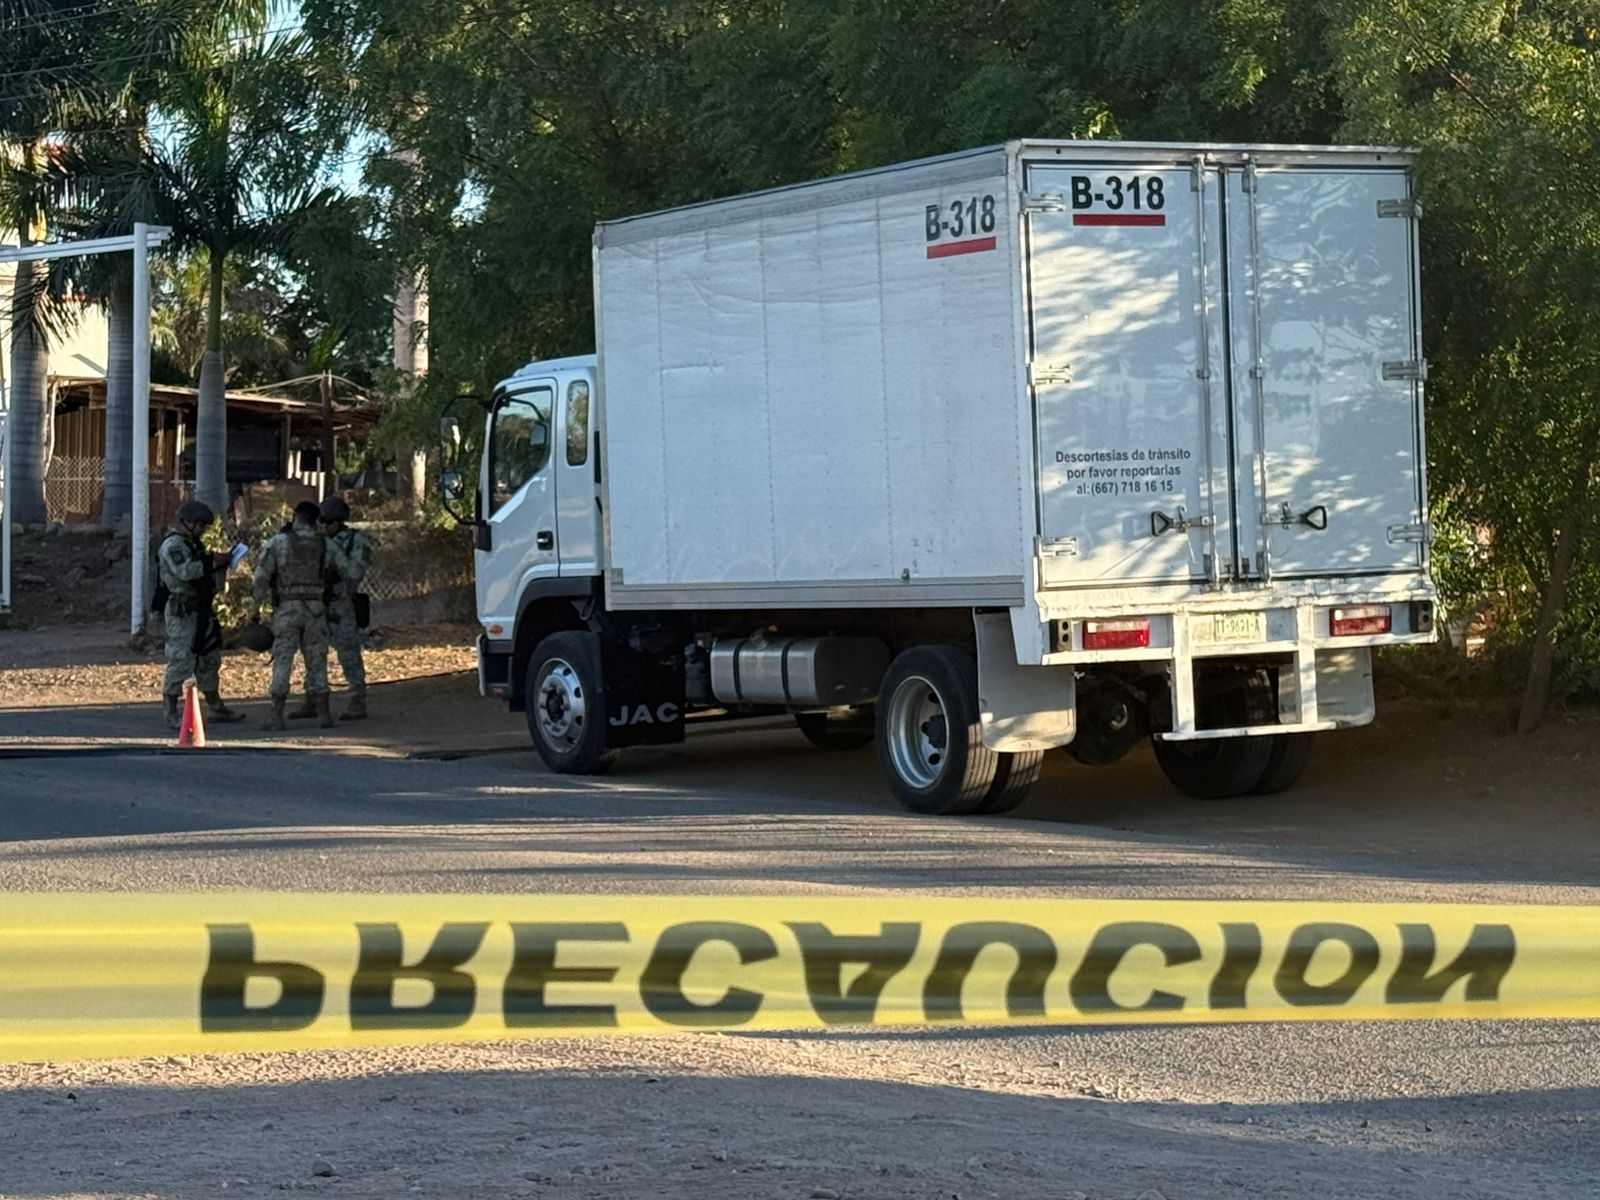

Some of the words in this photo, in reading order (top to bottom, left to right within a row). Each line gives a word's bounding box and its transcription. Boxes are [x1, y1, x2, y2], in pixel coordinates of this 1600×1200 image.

[1071, 176, 1165, 210] B-318
[926, 194, 996, 242] B-318
[1131, 449, 1146, 461] de
[1066, 469, 1086, 481] por
[1089, 466, 1118, 478] favor
[1120, 464, 1181, 479] reportarlas
[1121, 481, 1141, 493] 718
[1145, 480, 1157, 492] 16
[1160, 480, 1174, 492] 15
[609, 702, 679, 726] JAC
